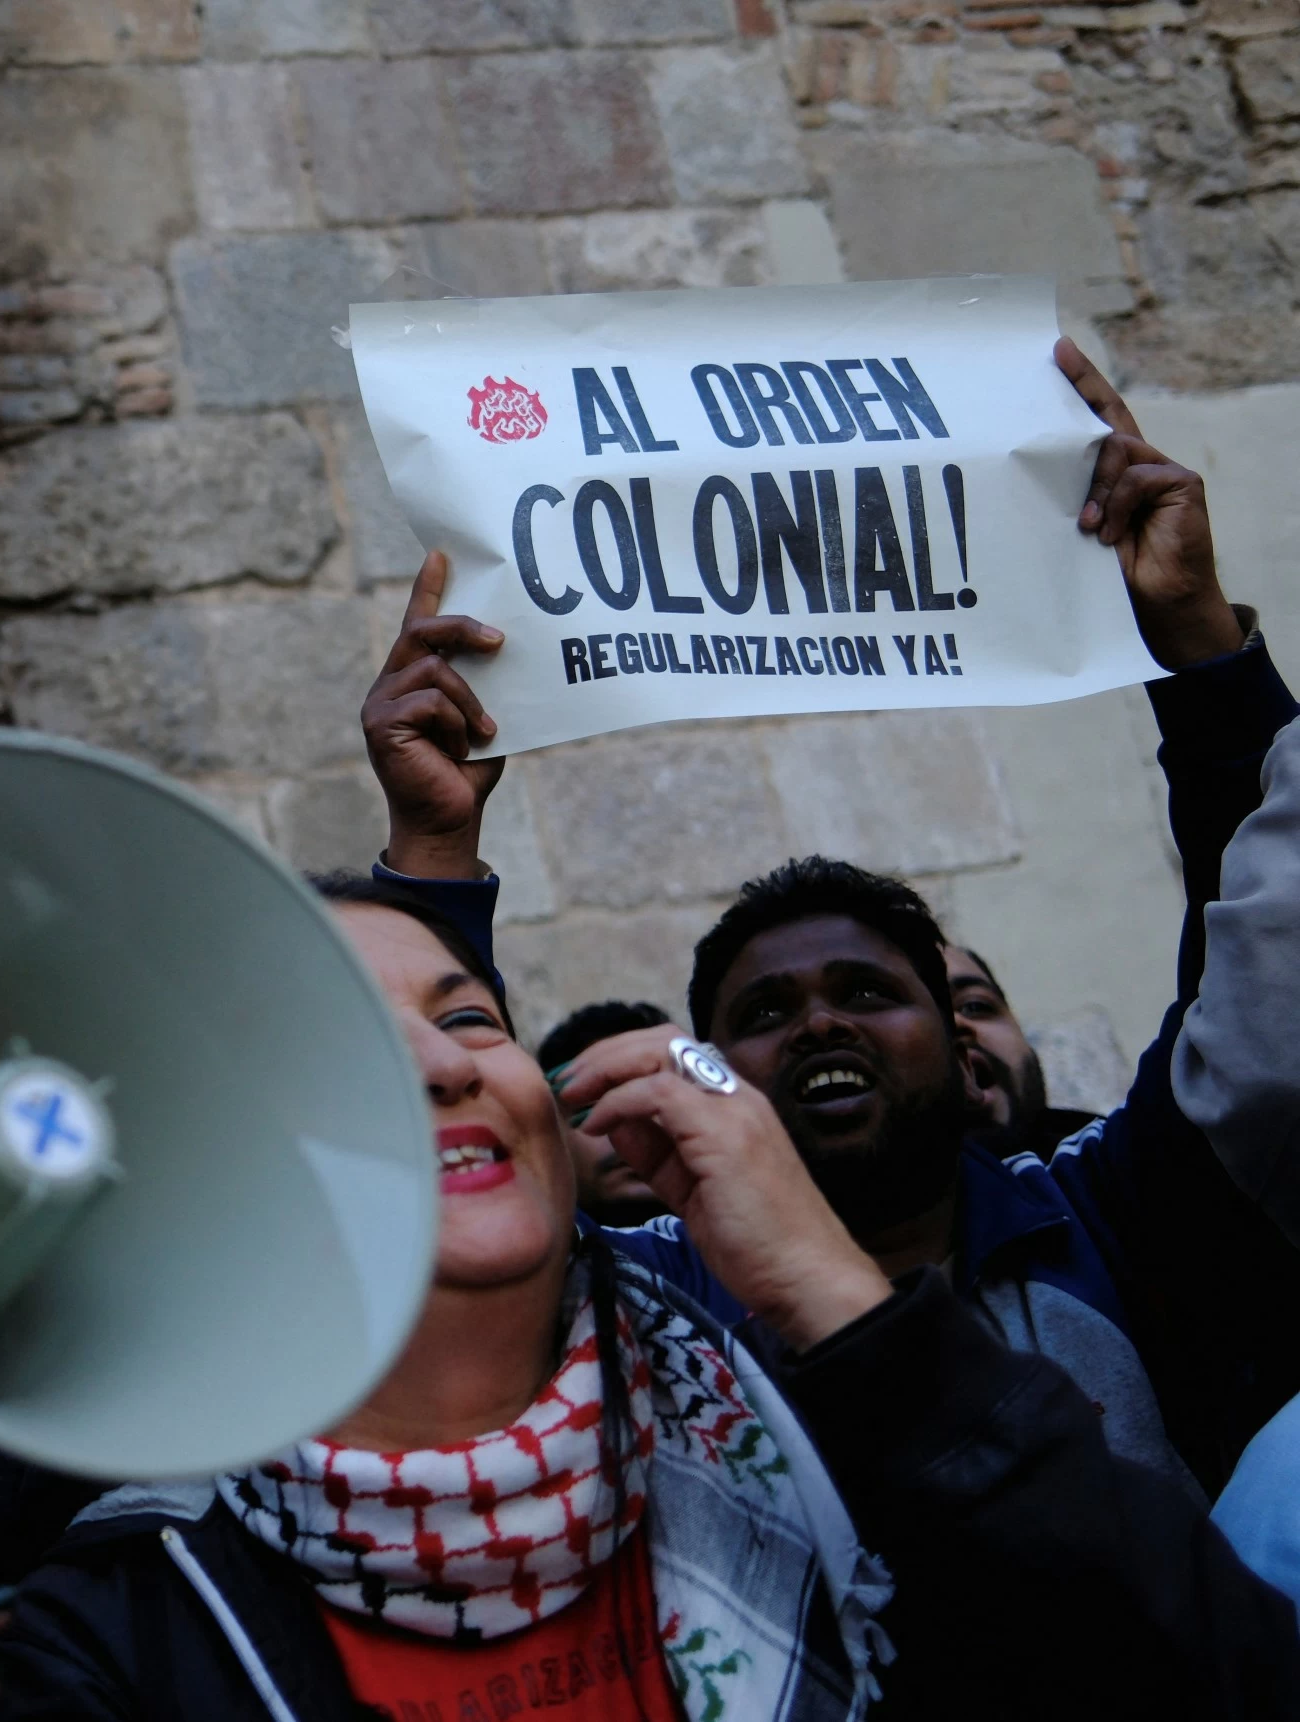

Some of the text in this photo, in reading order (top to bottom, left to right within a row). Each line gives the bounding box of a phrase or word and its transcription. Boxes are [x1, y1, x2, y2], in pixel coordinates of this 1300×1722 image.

[571, 356, 950, 455] AL ORDEN
[512, 463, 978, 616] COLONIAL!
[560, 632, 963, 686] REGULARIZACION YA!
